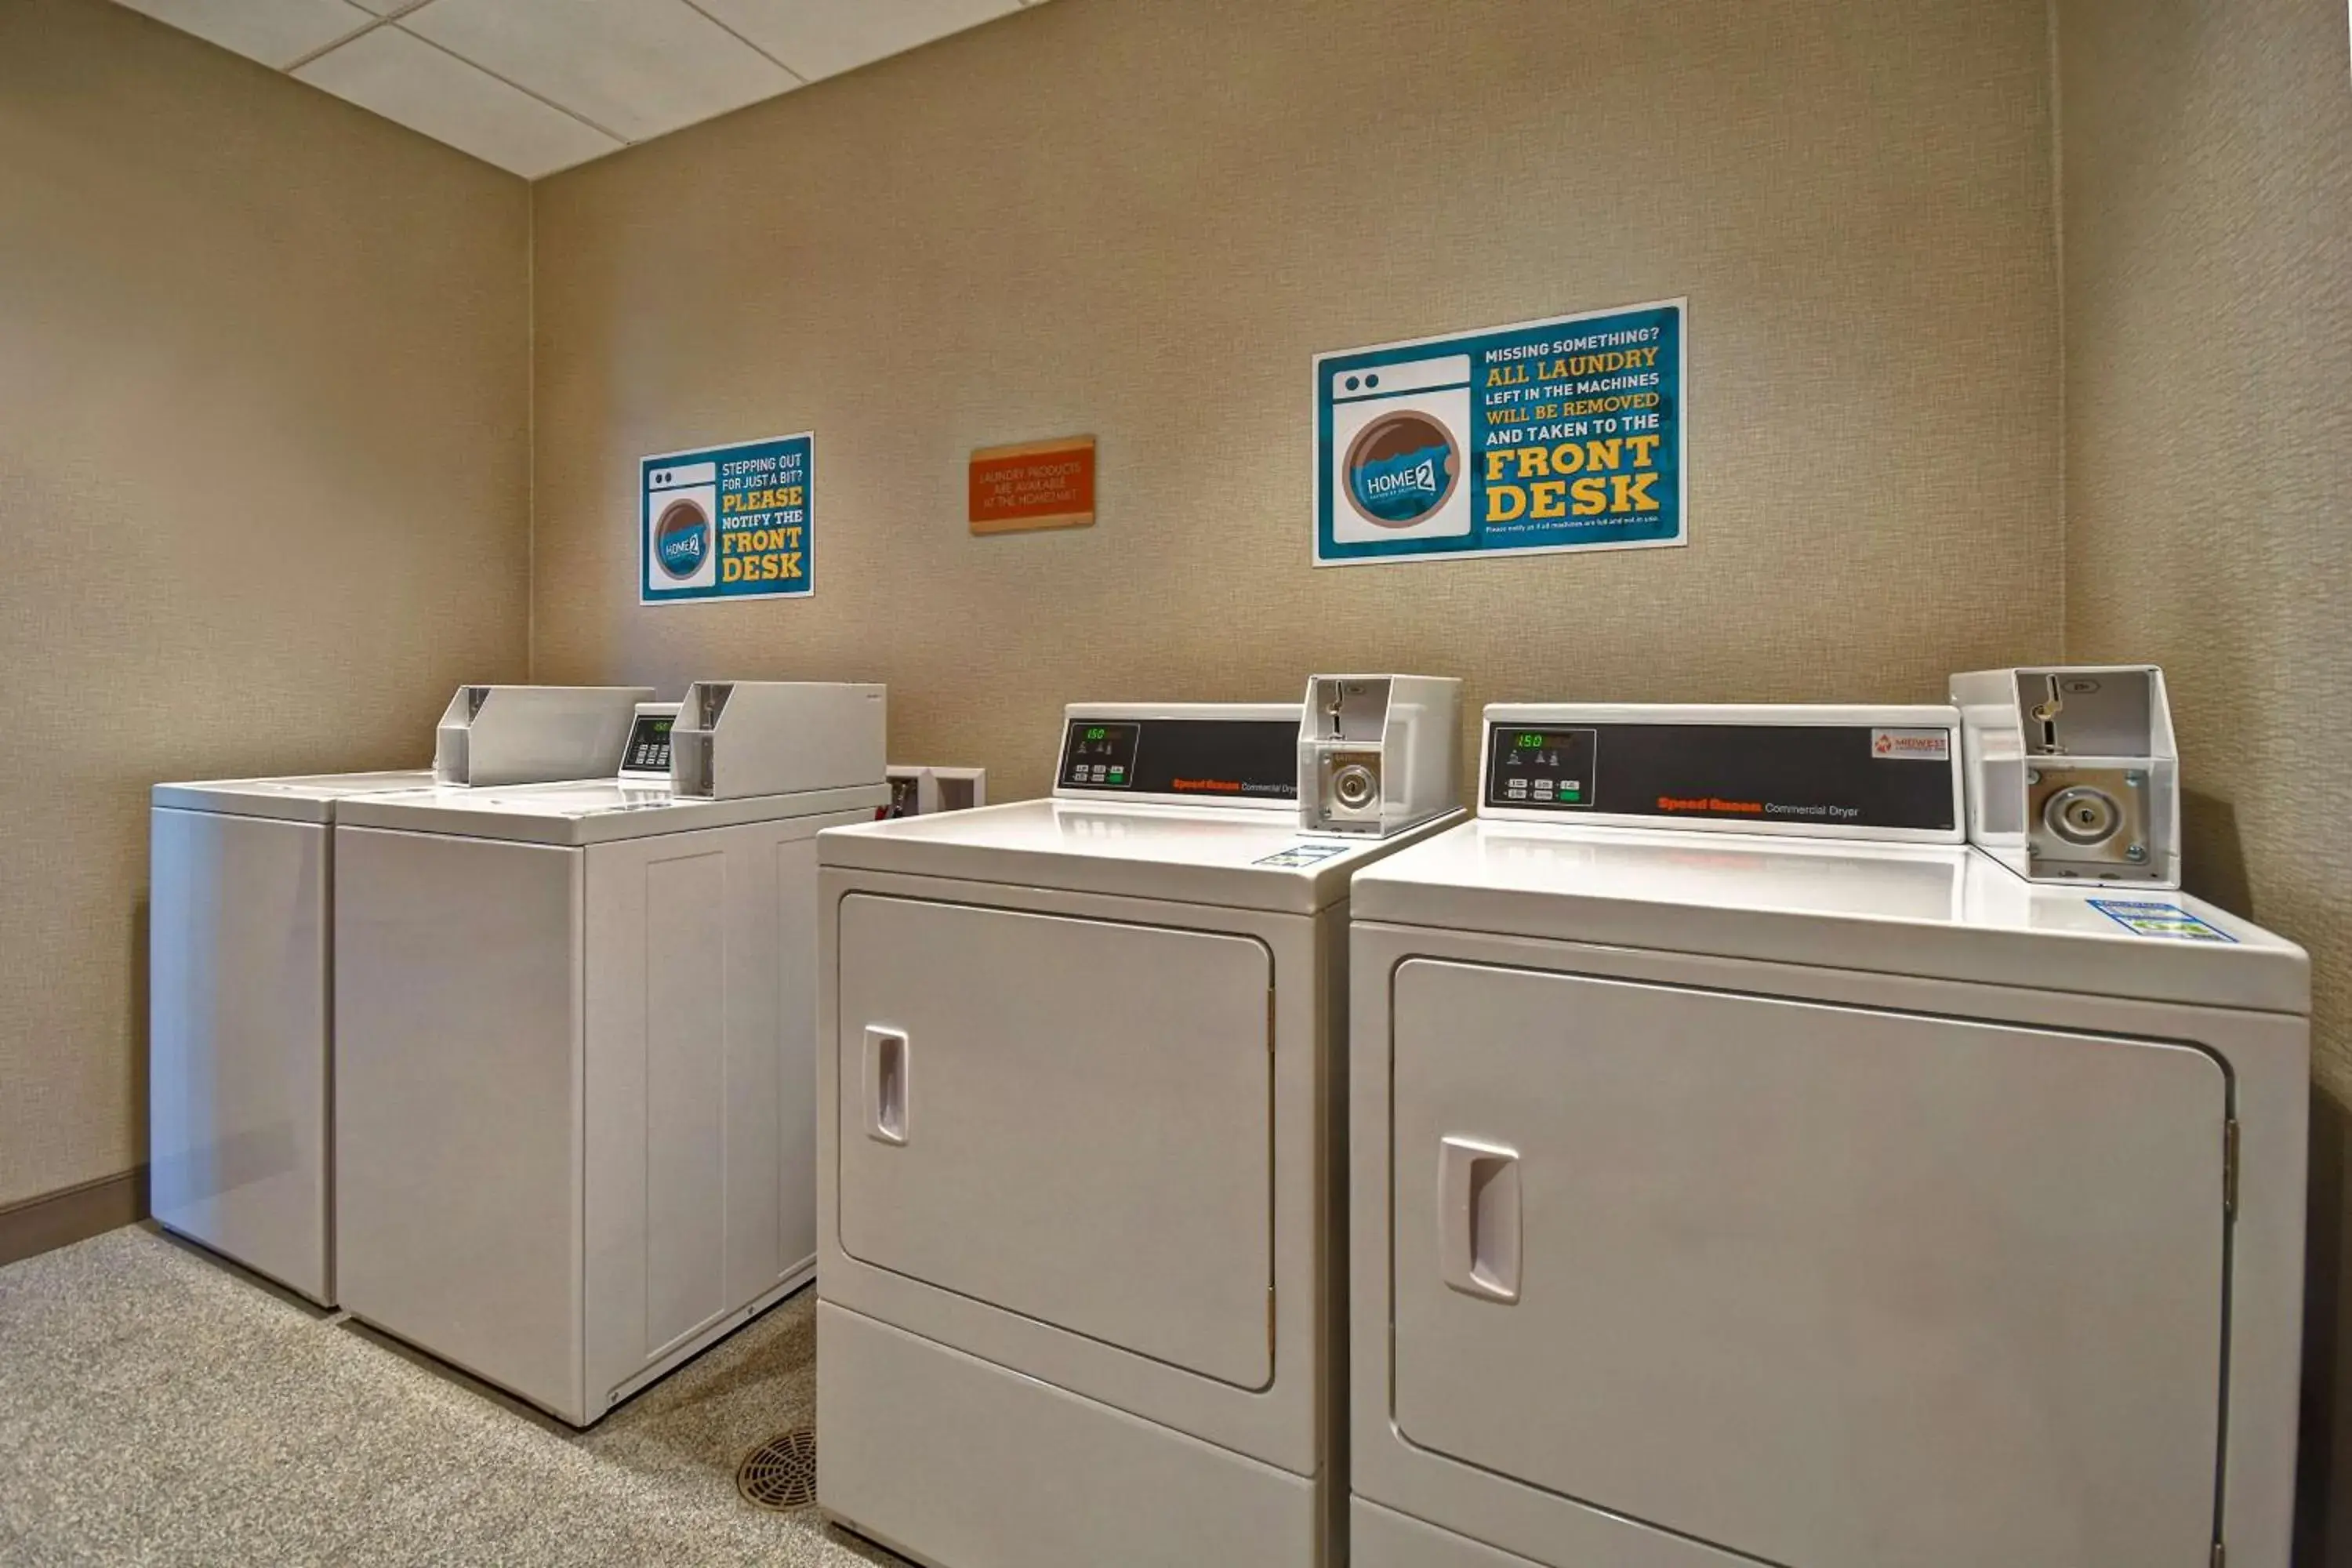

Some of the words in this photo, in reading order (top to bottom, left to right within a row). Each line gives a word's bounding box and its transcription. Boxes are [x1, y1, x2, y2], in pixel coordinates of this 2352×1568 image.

[1486, 343, 1549, 363] MISSING
[1552, 327, 1660, 354] SOMETHING?
[1486, 365, 1530, 387] ALL
[1537, 347, 1659, 381] LAUNDRY
[1486, 390, 1521, 405] LEFT
[1525, 388, 1540, 401] IN
[1544, 383, 1573, 397] THE
[1577, 372, 1660, 394] MACHINES
[1486, 407, 1530, 426] WILL
[1535, 404, 1558, 419] BE
[1563, 392, 1660, 416] REMOVED
[1486, 429, 1523, 446] AND
[1527, 421, 1588, 441] TAKEN
[1593, 418, 1617, 433] TO
[1622, 413, 1660, 430] THE
[722, 457, 776, 477] STEPPING
[779, 453, 802, 469] OUT
[1486, 434, 1660, 481] FRONT
[722, 477, 741, 492] FOR
[743, 474, 769, 488] JUST
[770, 472, 778, 485] A
[780, 470, 803, 484] BIT?
[1486, 472, 1660, 521] DESK
[722, 486, 803, 514] PLEASE
[722, 513, 771, 530] NOTIFY
[775, 510, 803, 524] THE
[722, 527, 802, 554] FRONT
[722, 552, 802, 583] DESK
[1766, 802, 1827, 815] Commercial
[1829, 805, 1859, 818] Dryer
